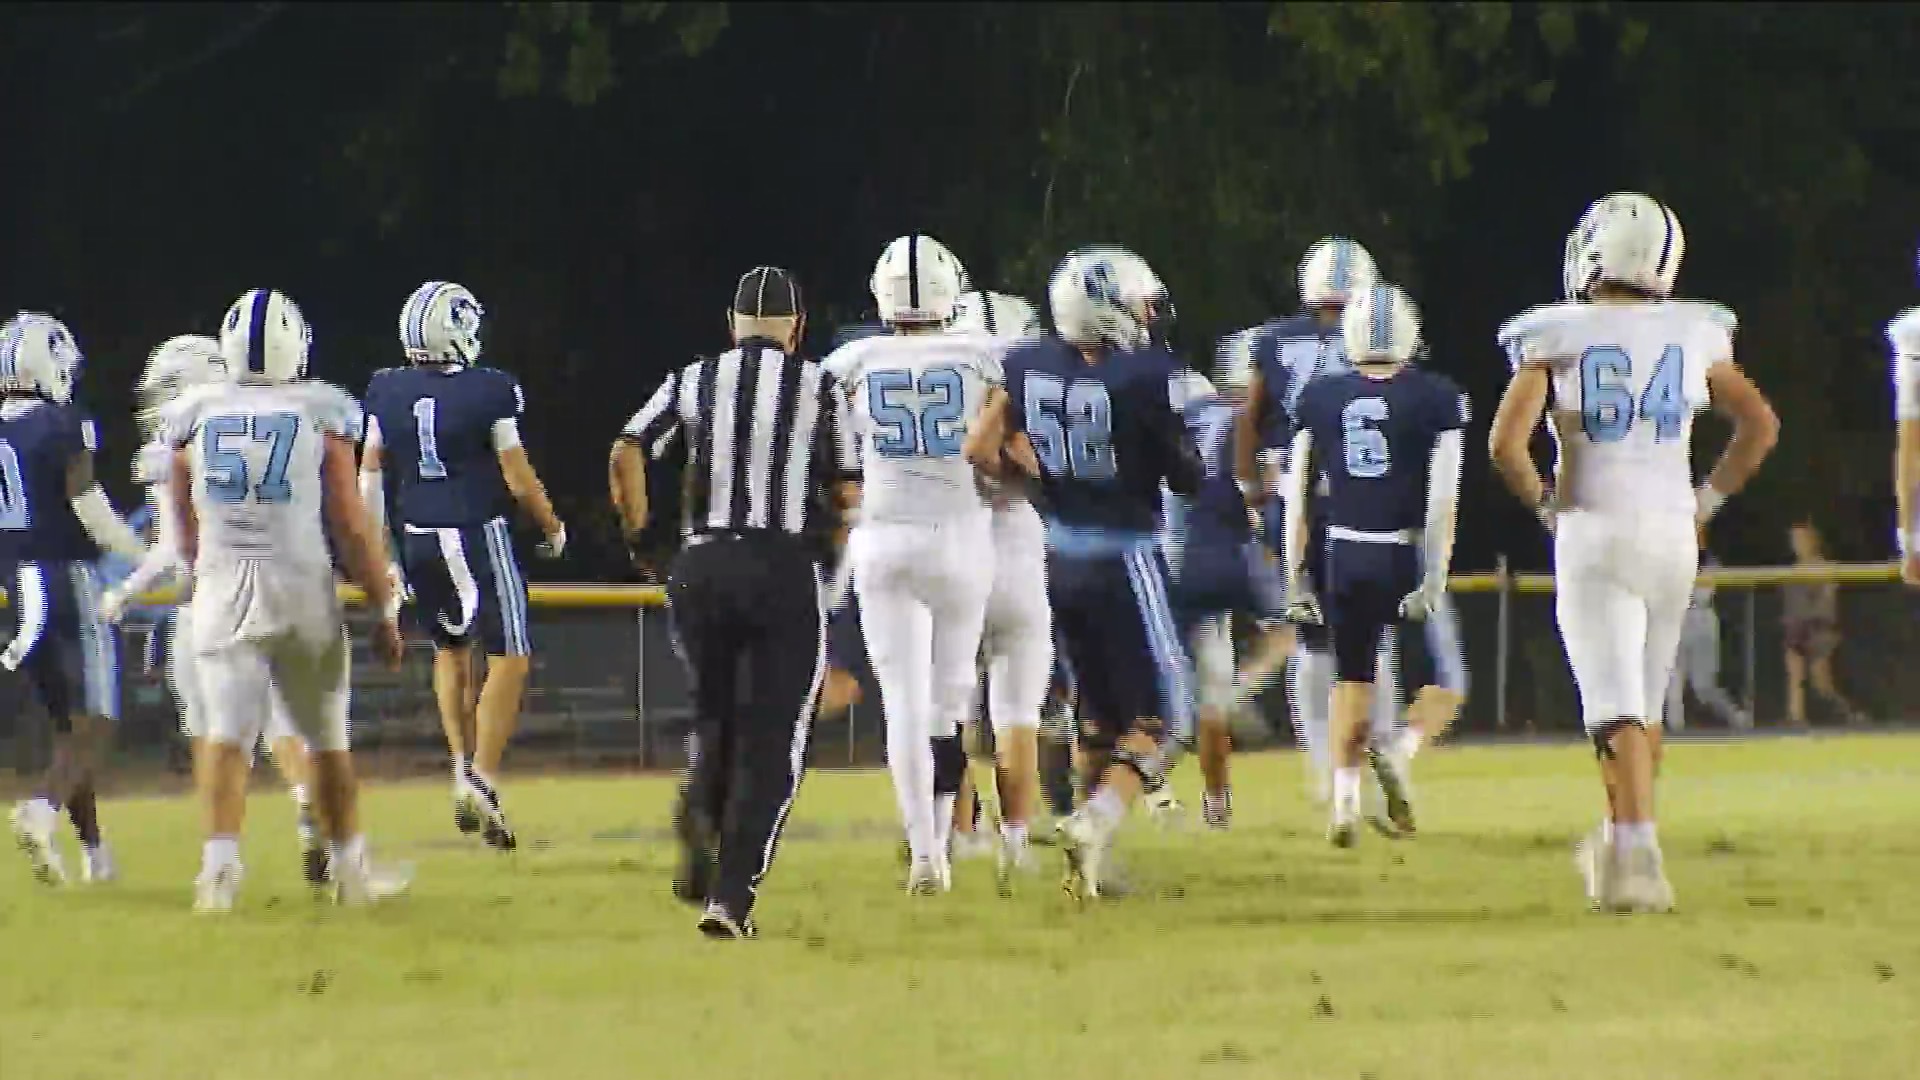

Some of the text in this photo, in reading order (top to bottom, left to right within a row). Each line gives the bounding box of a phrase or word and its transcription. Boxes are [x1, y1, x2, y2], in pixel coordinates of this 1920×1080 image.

[412, 397, 448, 480] 1
[866, 363, 969, 458] 52
[1341, 397, 1391, 478] 6
[1579, 343, 1685, 444] 64
[203, 410, 300, 504] 57
